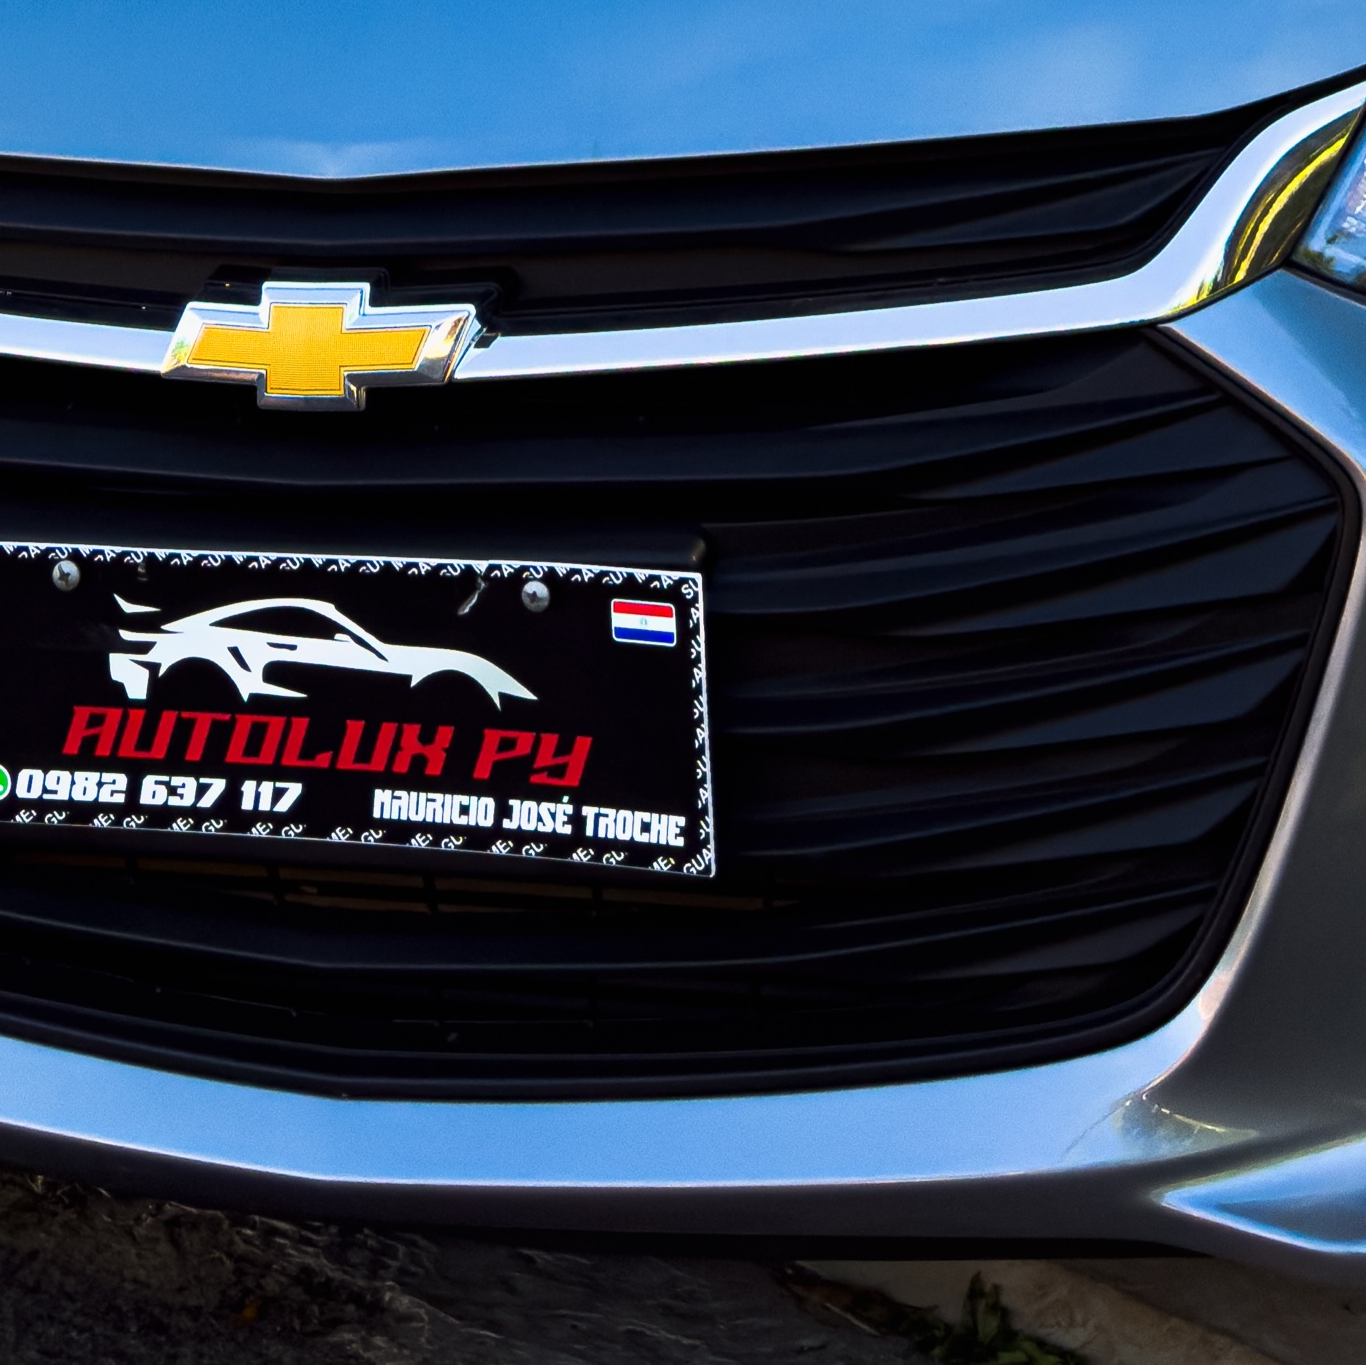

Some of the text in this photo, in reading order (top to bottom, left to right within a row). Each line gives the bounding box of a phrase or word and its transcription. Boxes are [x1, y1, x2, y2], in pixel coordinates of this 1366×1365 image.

[62, 706, 592, 787] AUTOLUX PY
[15, 768, 303, 812] 0982 637 117
[372, 788, 496, 827] MAURICIO
[502, 795, 574, 835] JOSÉ
[581, 805, 686, 847] TROCHE
